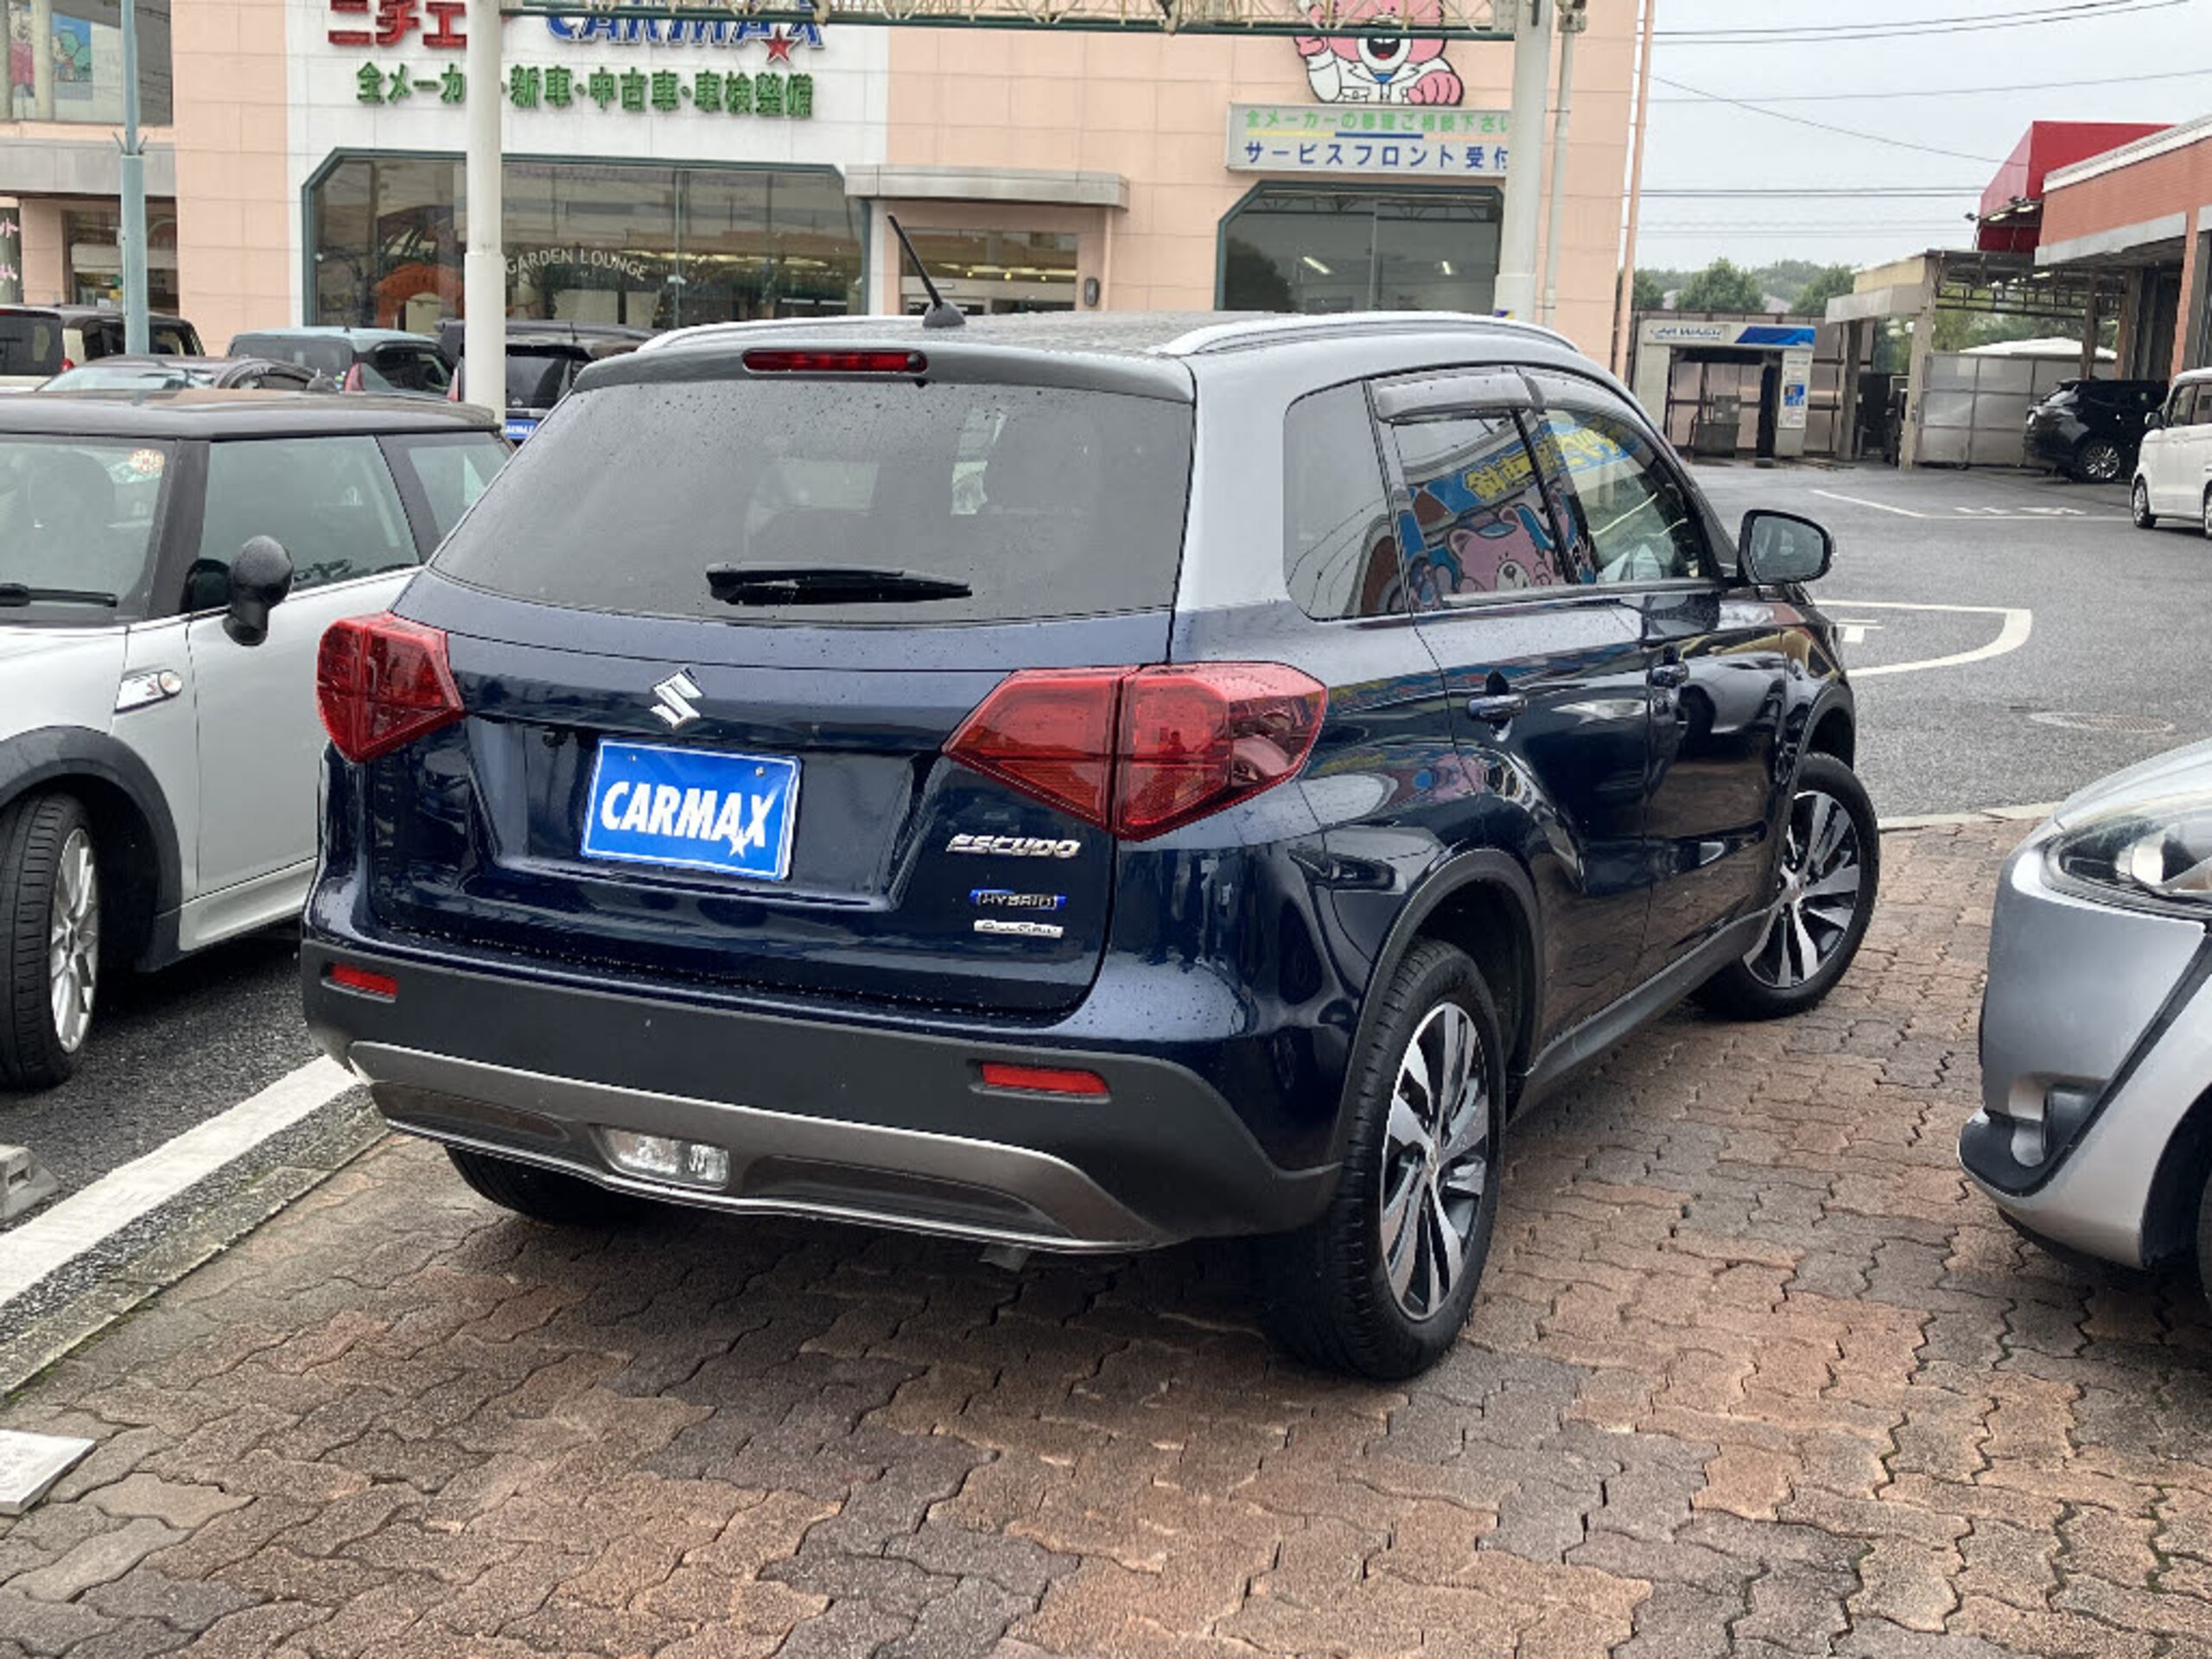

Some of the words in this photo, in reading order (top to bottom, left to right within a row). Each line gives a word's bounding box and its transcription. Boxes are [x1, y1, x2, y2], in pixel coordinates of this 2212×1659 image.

[327, 0, 510, 48] ニチエ
[357, 61, 814, 118] 全メーカ・新車・中古車・車検整備
[506, 248, 574, 275] GARDEN
[580, 248, 649, 282] LOUNGE
[600, 780, 781, 849] CARMAX
[945, 833, 1081, 859] ESCUDO
[982, 892, 1052, 908] HYBRID
